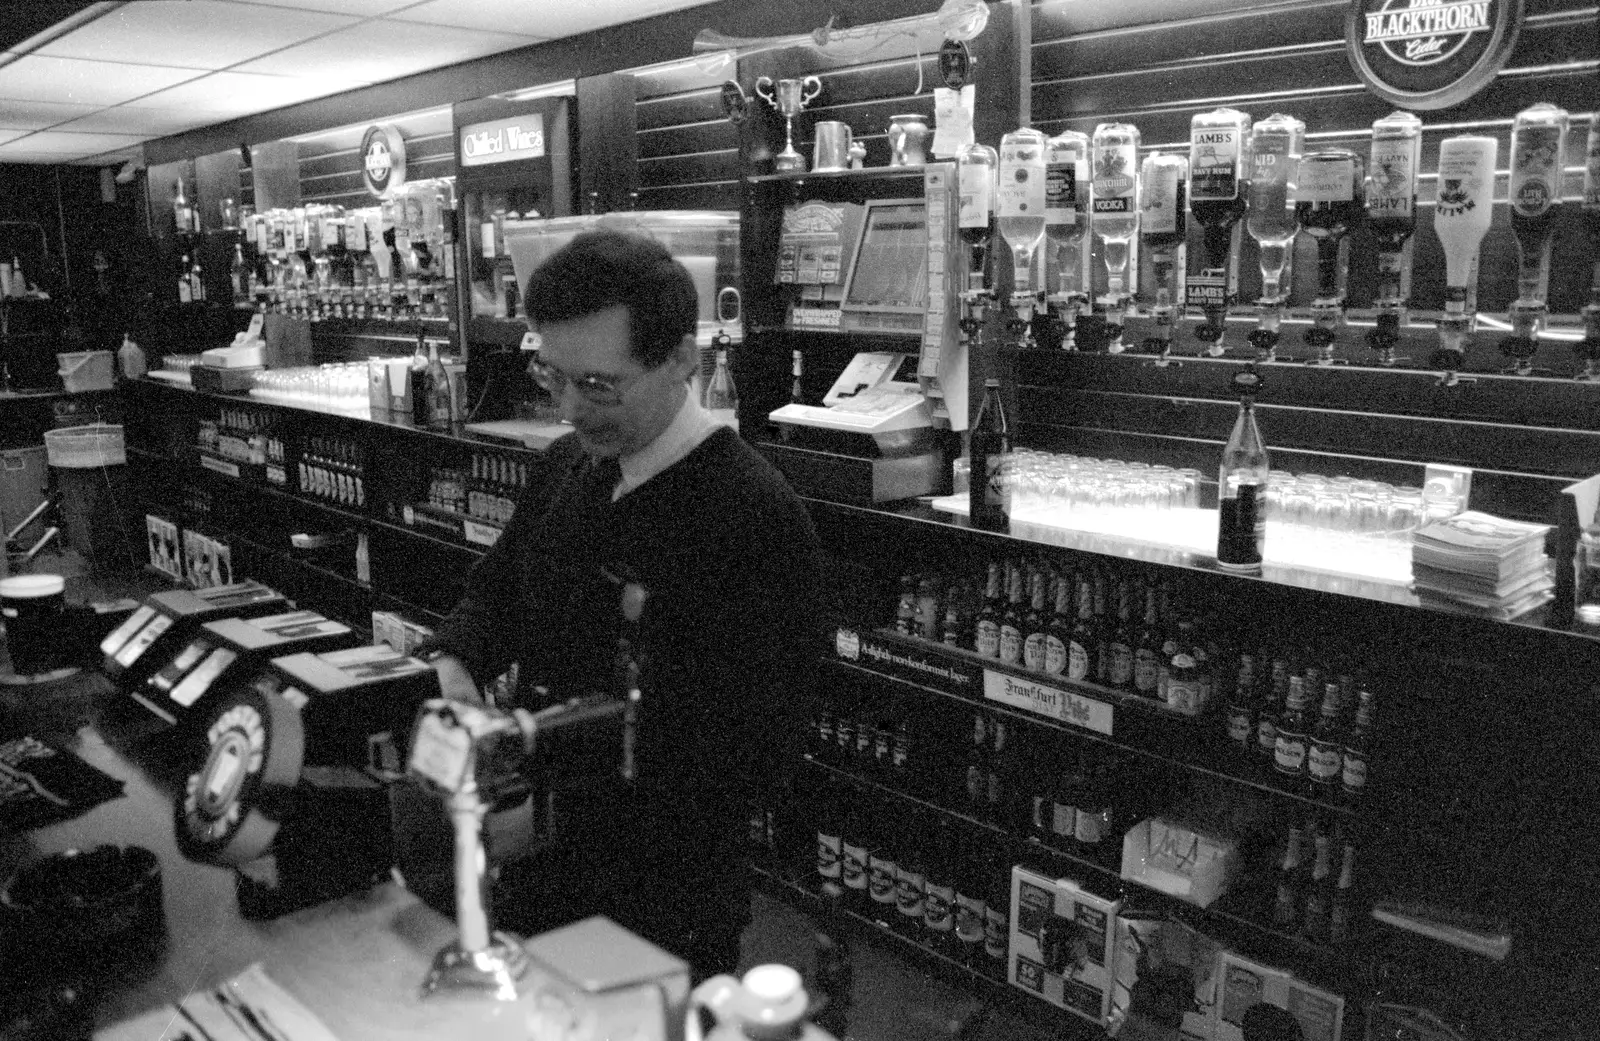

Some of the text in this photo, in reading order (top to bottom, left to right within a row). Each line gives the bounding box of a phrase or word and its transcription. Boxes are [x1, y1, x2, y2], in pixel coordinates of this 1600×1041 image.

[1366, 3, 1488, 39] BLACKTHORN
[1405, 37, 1447, 58] Cider
[464, 126, 543, 157] Chilled Wines
[1195, 133, 1232, 144] LAMB'S
[1212, 167, 1231, 175] RUM
[1096, 200, 1125, 211] VODKA
[1188, 287, 1224, 297] LAMB'S
